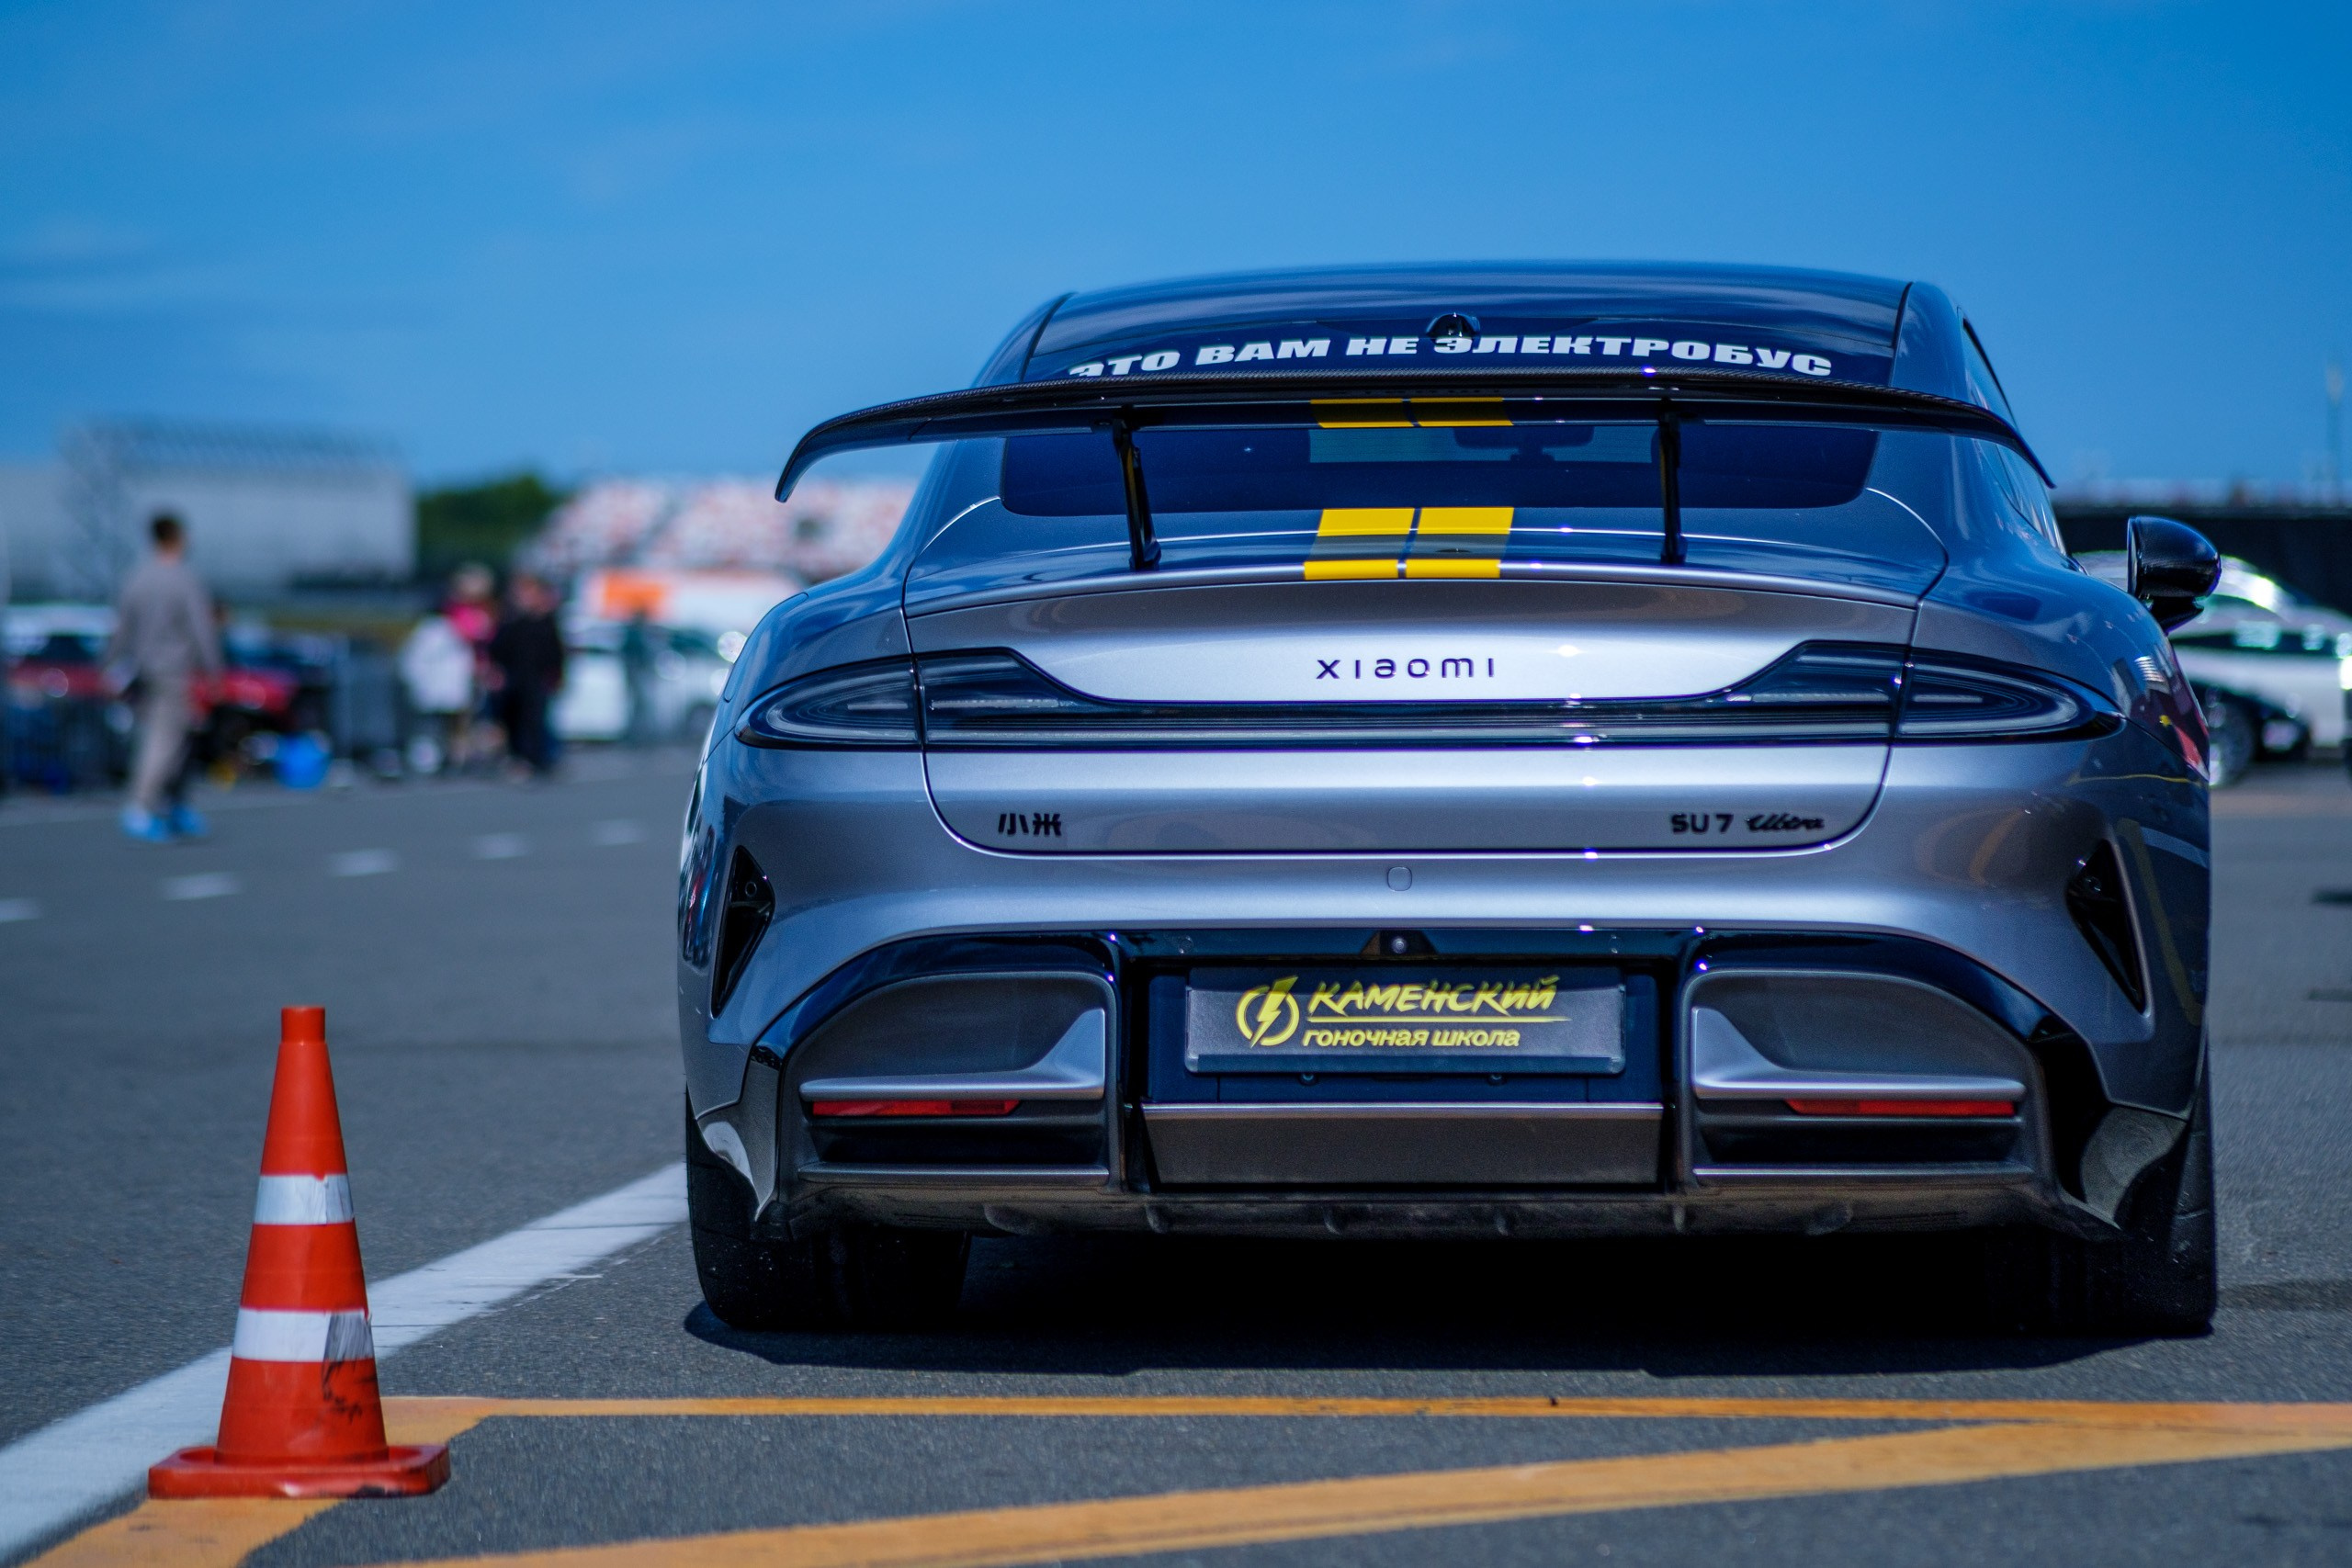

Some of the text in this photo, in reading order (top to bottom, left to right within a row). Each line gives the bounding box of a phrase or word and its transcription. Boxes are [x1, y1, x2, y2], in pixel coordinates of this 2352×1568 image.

[1195, 337, 1331, 366] ВАМ
[1346, 336, 1419, 355] НЕ
[1433, 335, 1832, 377] ЭЛЕКТРОБУС
[1316, 658, 1495, 681] xiaomi
[998, 813, 1062, 836] 小米
[1671, 814, 1735, 834] SU7
[1308, 976, 1561, 1017] КАМЕНСКИЙ
[1303, 1029, 1521, 1047] гоночная школа
